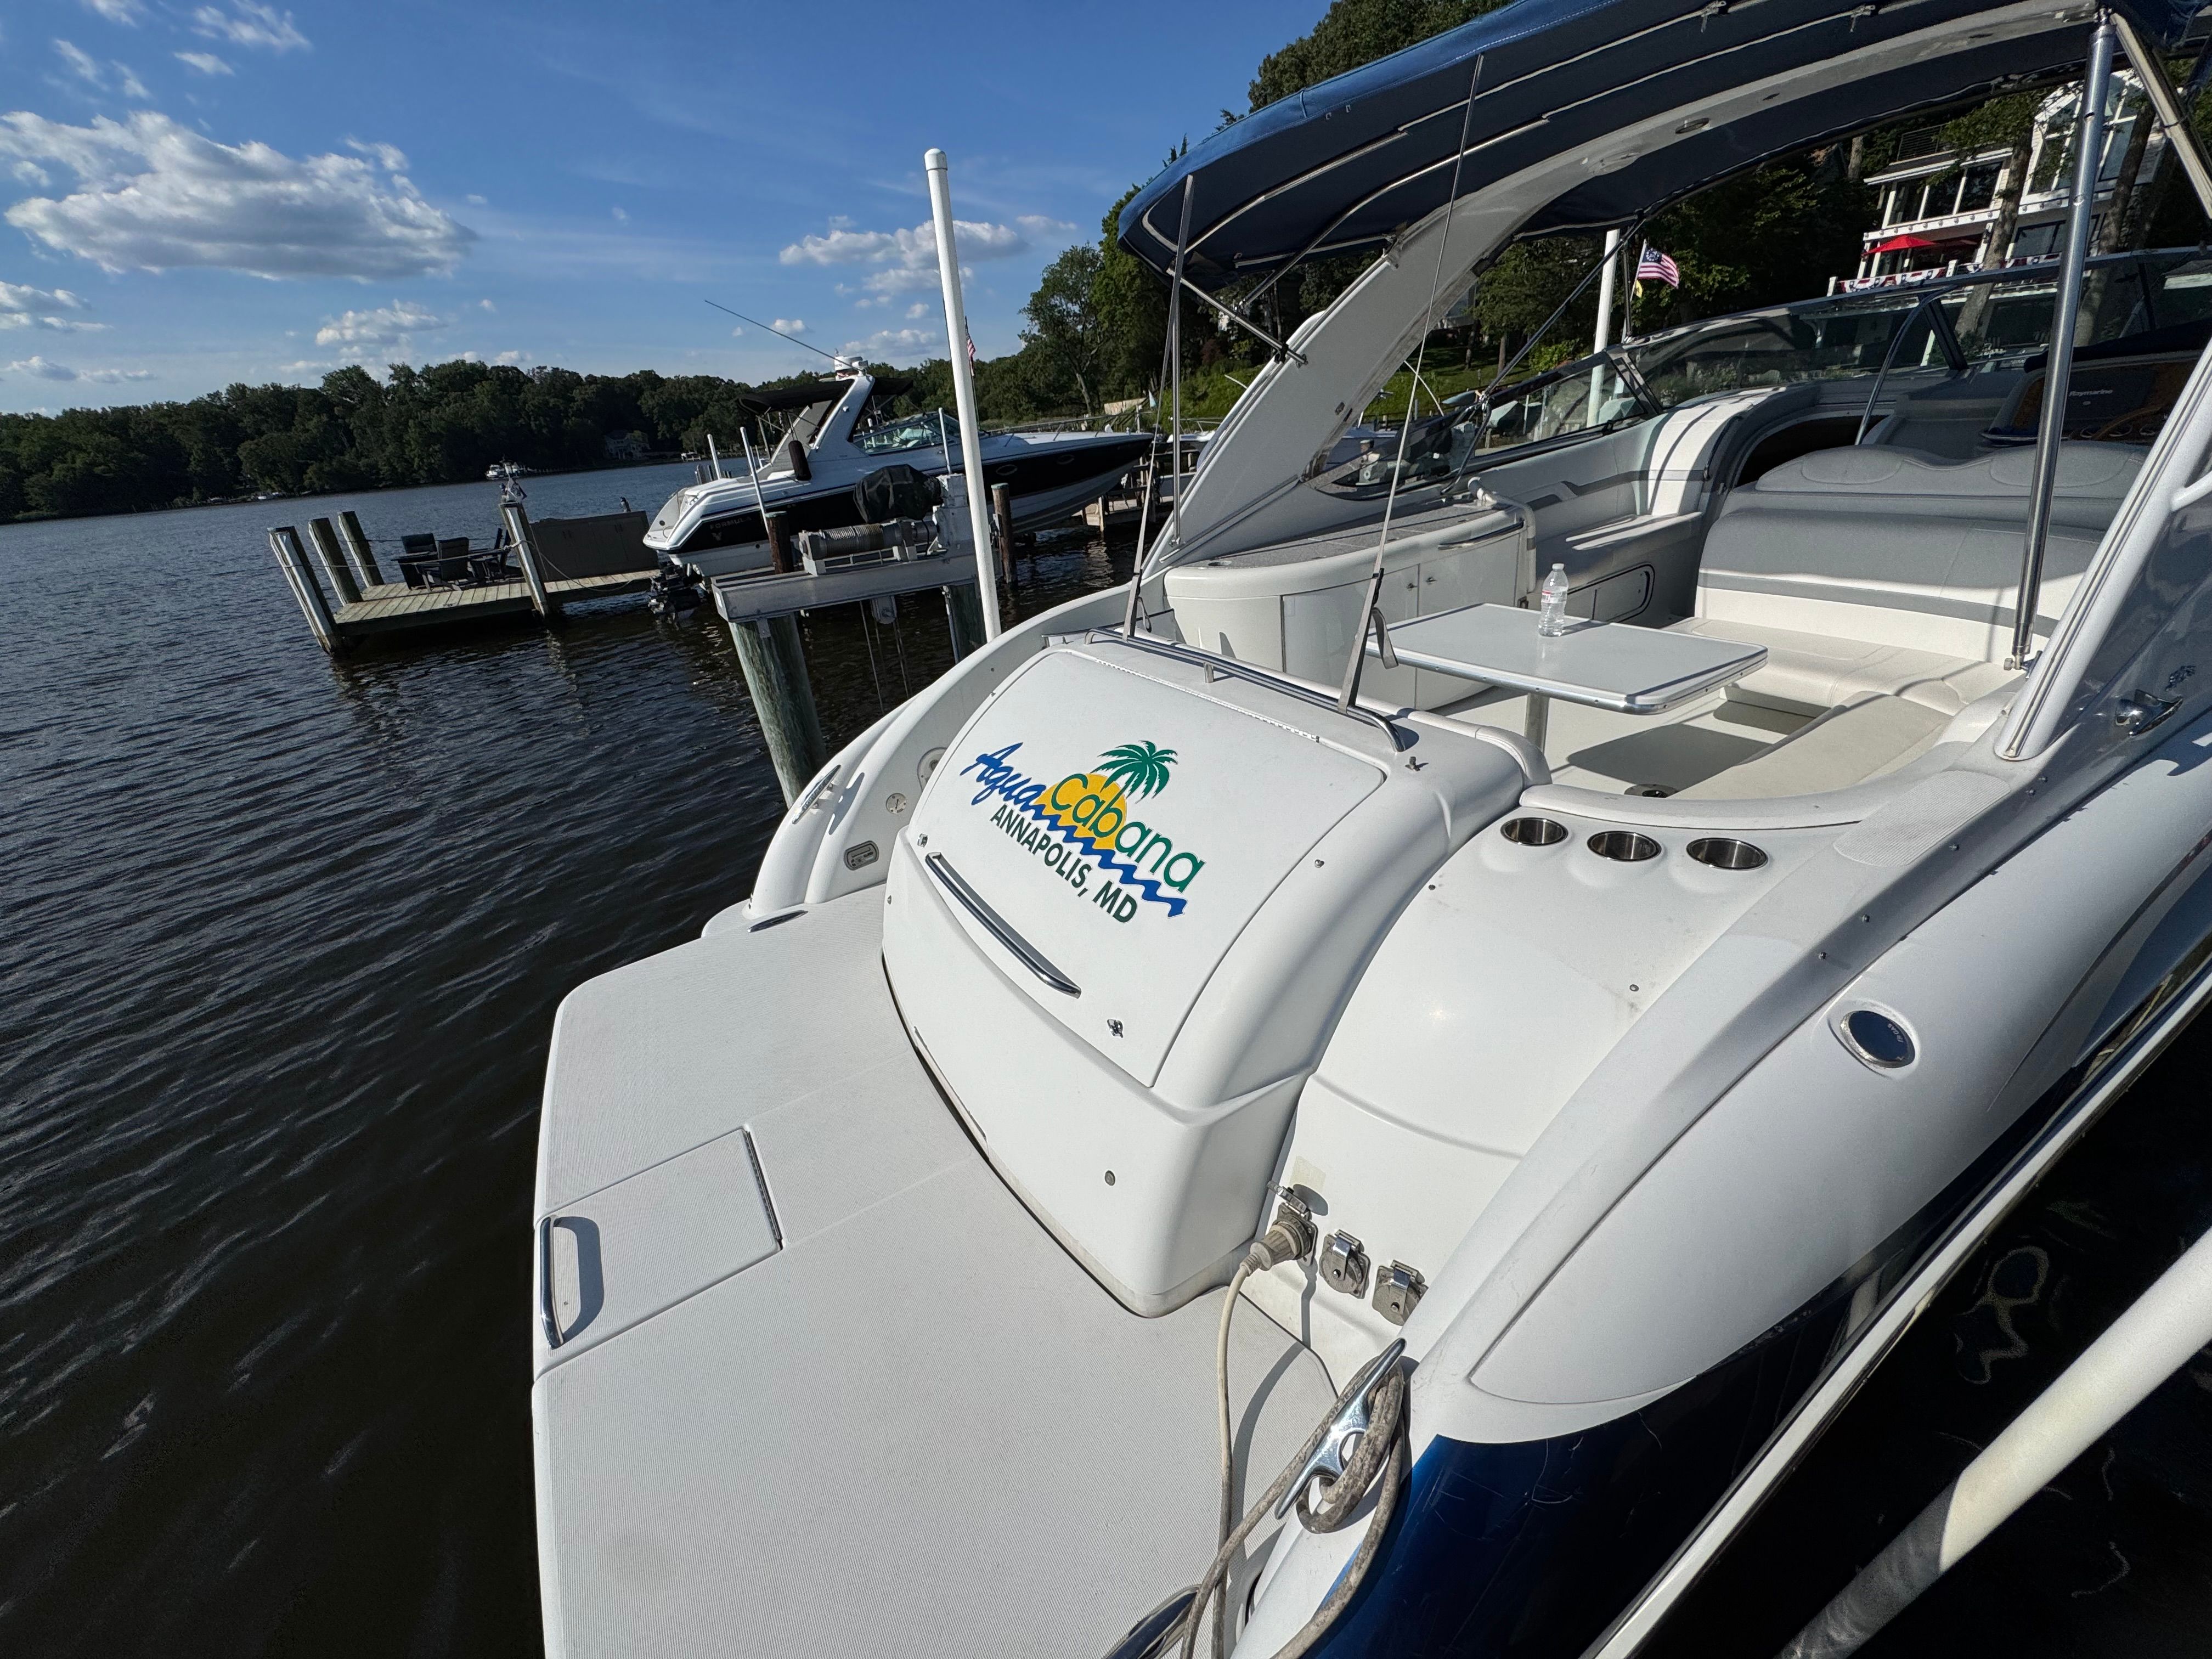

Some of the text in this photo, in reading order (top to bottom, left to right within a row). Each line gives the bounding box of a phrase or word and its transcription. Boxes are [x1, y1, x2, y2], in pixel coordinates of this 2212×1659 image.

[710, 517, 752, 529] FORMULA
[990, 804, 1138, 923] ANNAPOLIS, MD
[1051, 774, 1206, 893] Cabana
